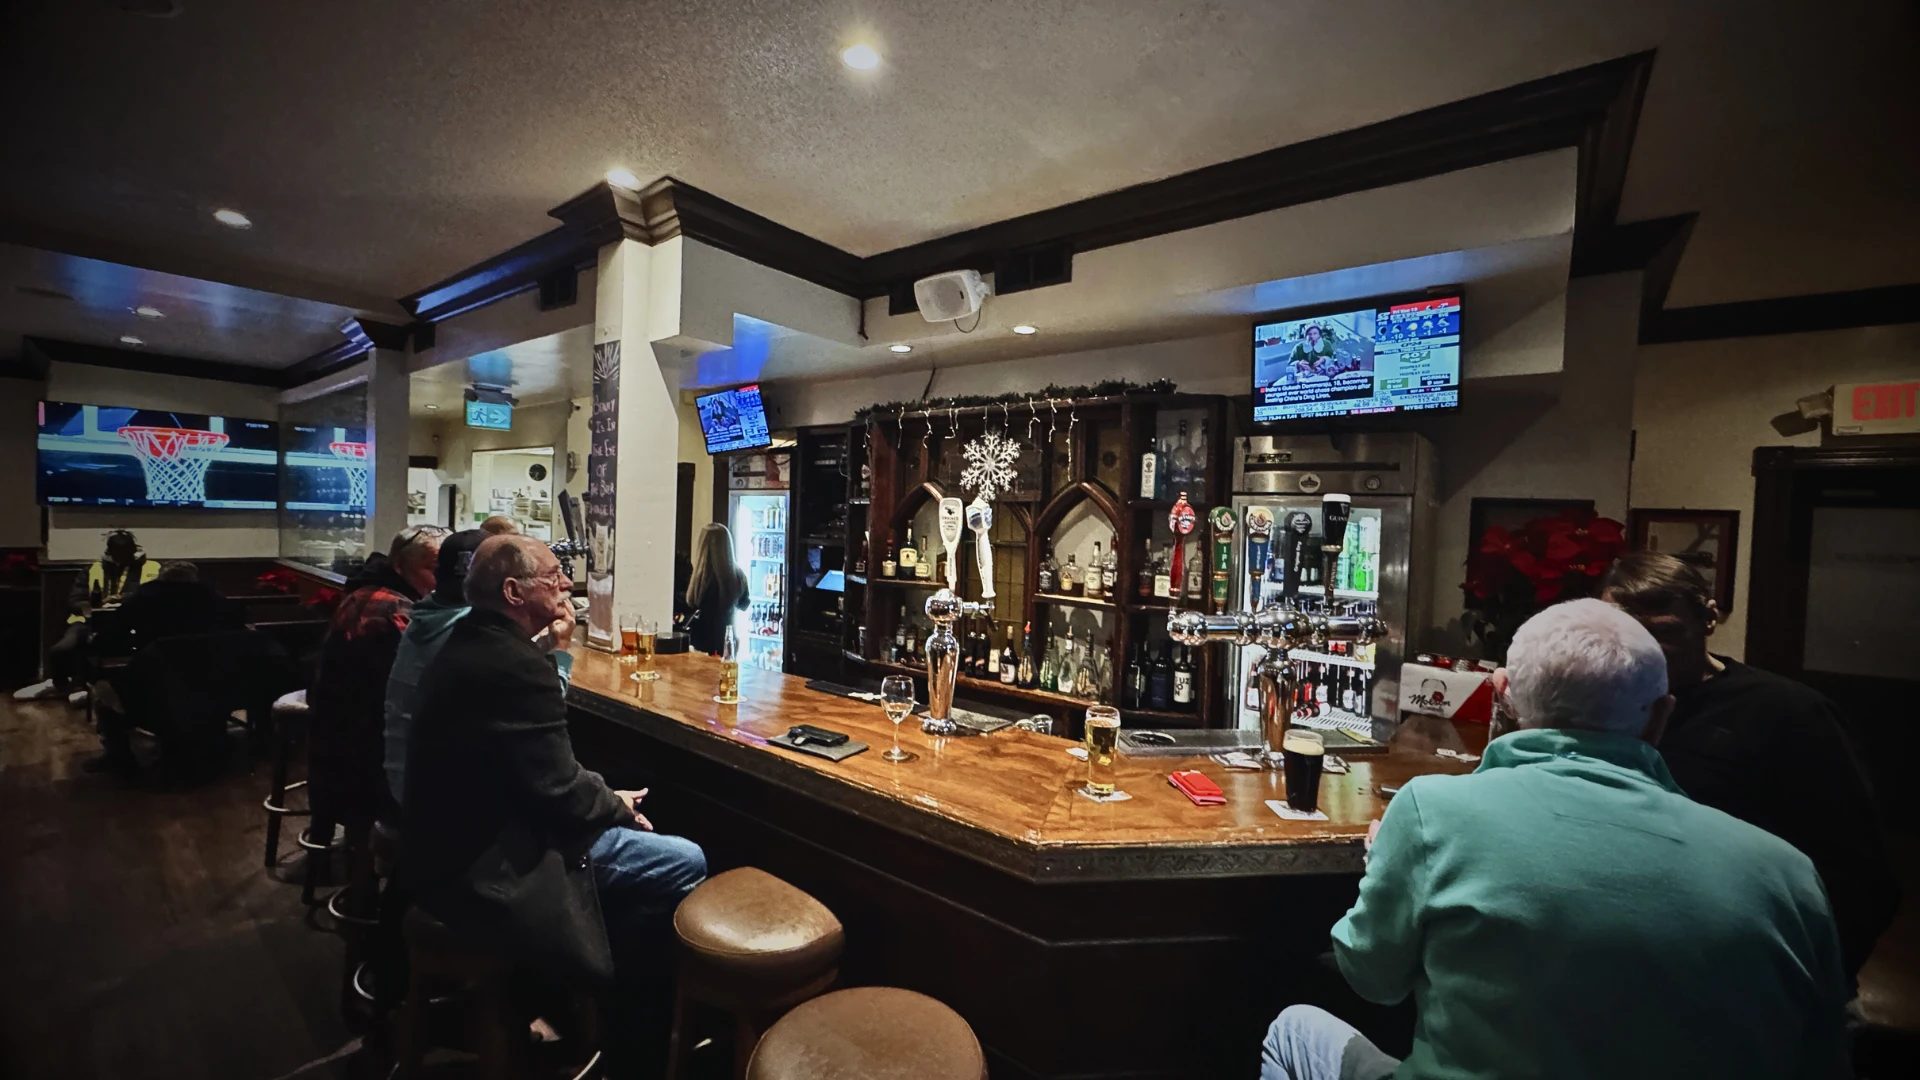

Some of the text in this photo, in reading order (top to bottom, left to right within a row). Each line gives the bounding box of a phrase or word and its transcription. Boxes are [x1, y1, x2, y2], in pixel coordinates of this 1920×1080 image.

[1401, 351, 1430, 360] 407
[1331, 384, 1357, 392] champion
[1284, 394, 1303, 402] China's
[1853, 383, 1920, 421] EXIT
[1373, 405, 1396, 413] DELAY
[596, 463, 608, 477] OF
